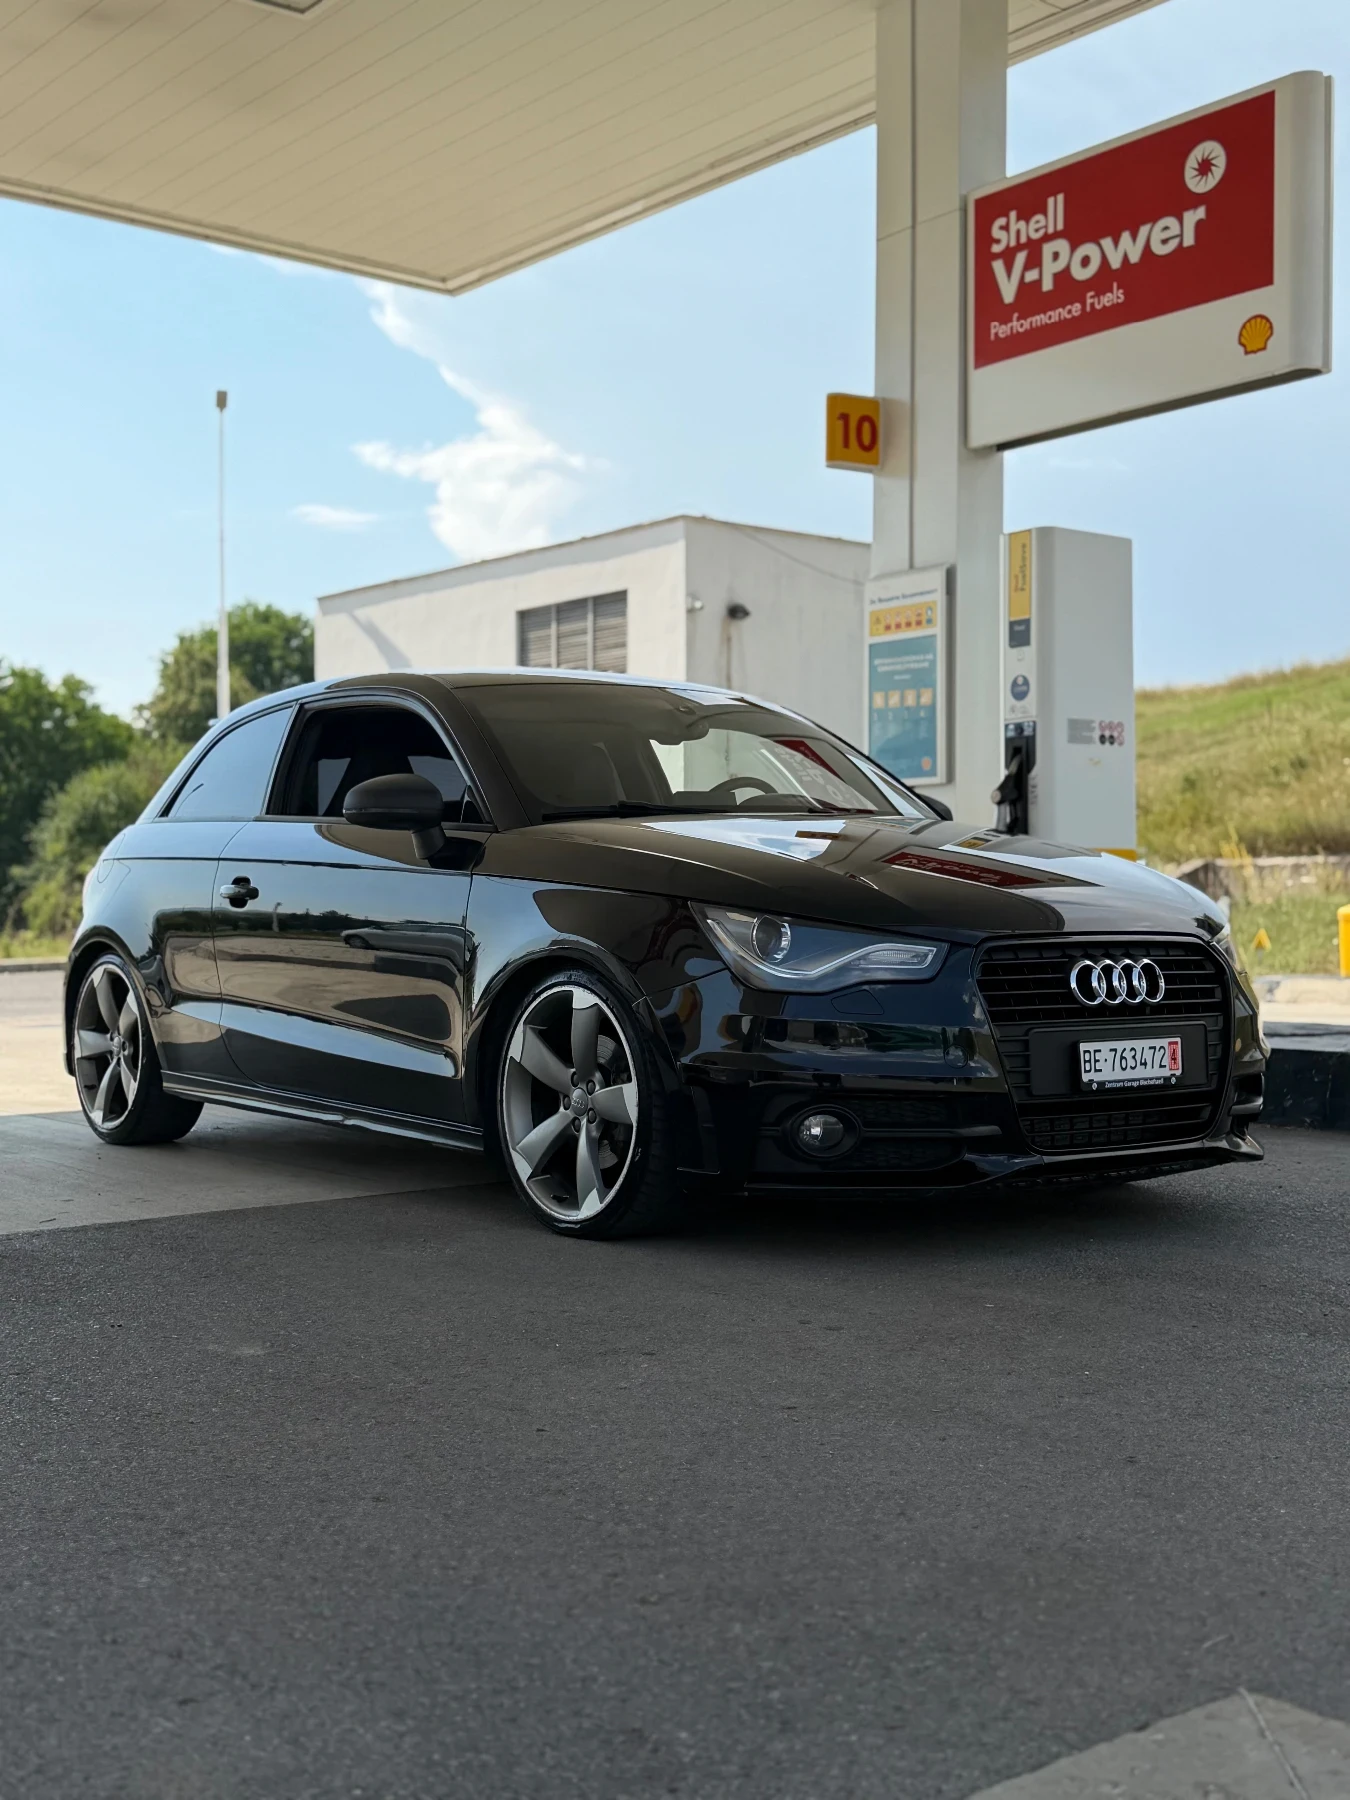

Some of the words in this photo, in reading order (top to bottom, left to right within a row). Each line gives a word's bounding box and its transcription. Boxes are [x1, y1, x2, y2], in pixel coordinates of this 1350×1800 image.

[991, 193, 1064, 253] Shell
[991, 205, 1206, 305] V-Power
[990, 303, 1081, 341] Performance
[1086, 282, 1125, 313] Fuels
[837, 412, 878, 453] 10
